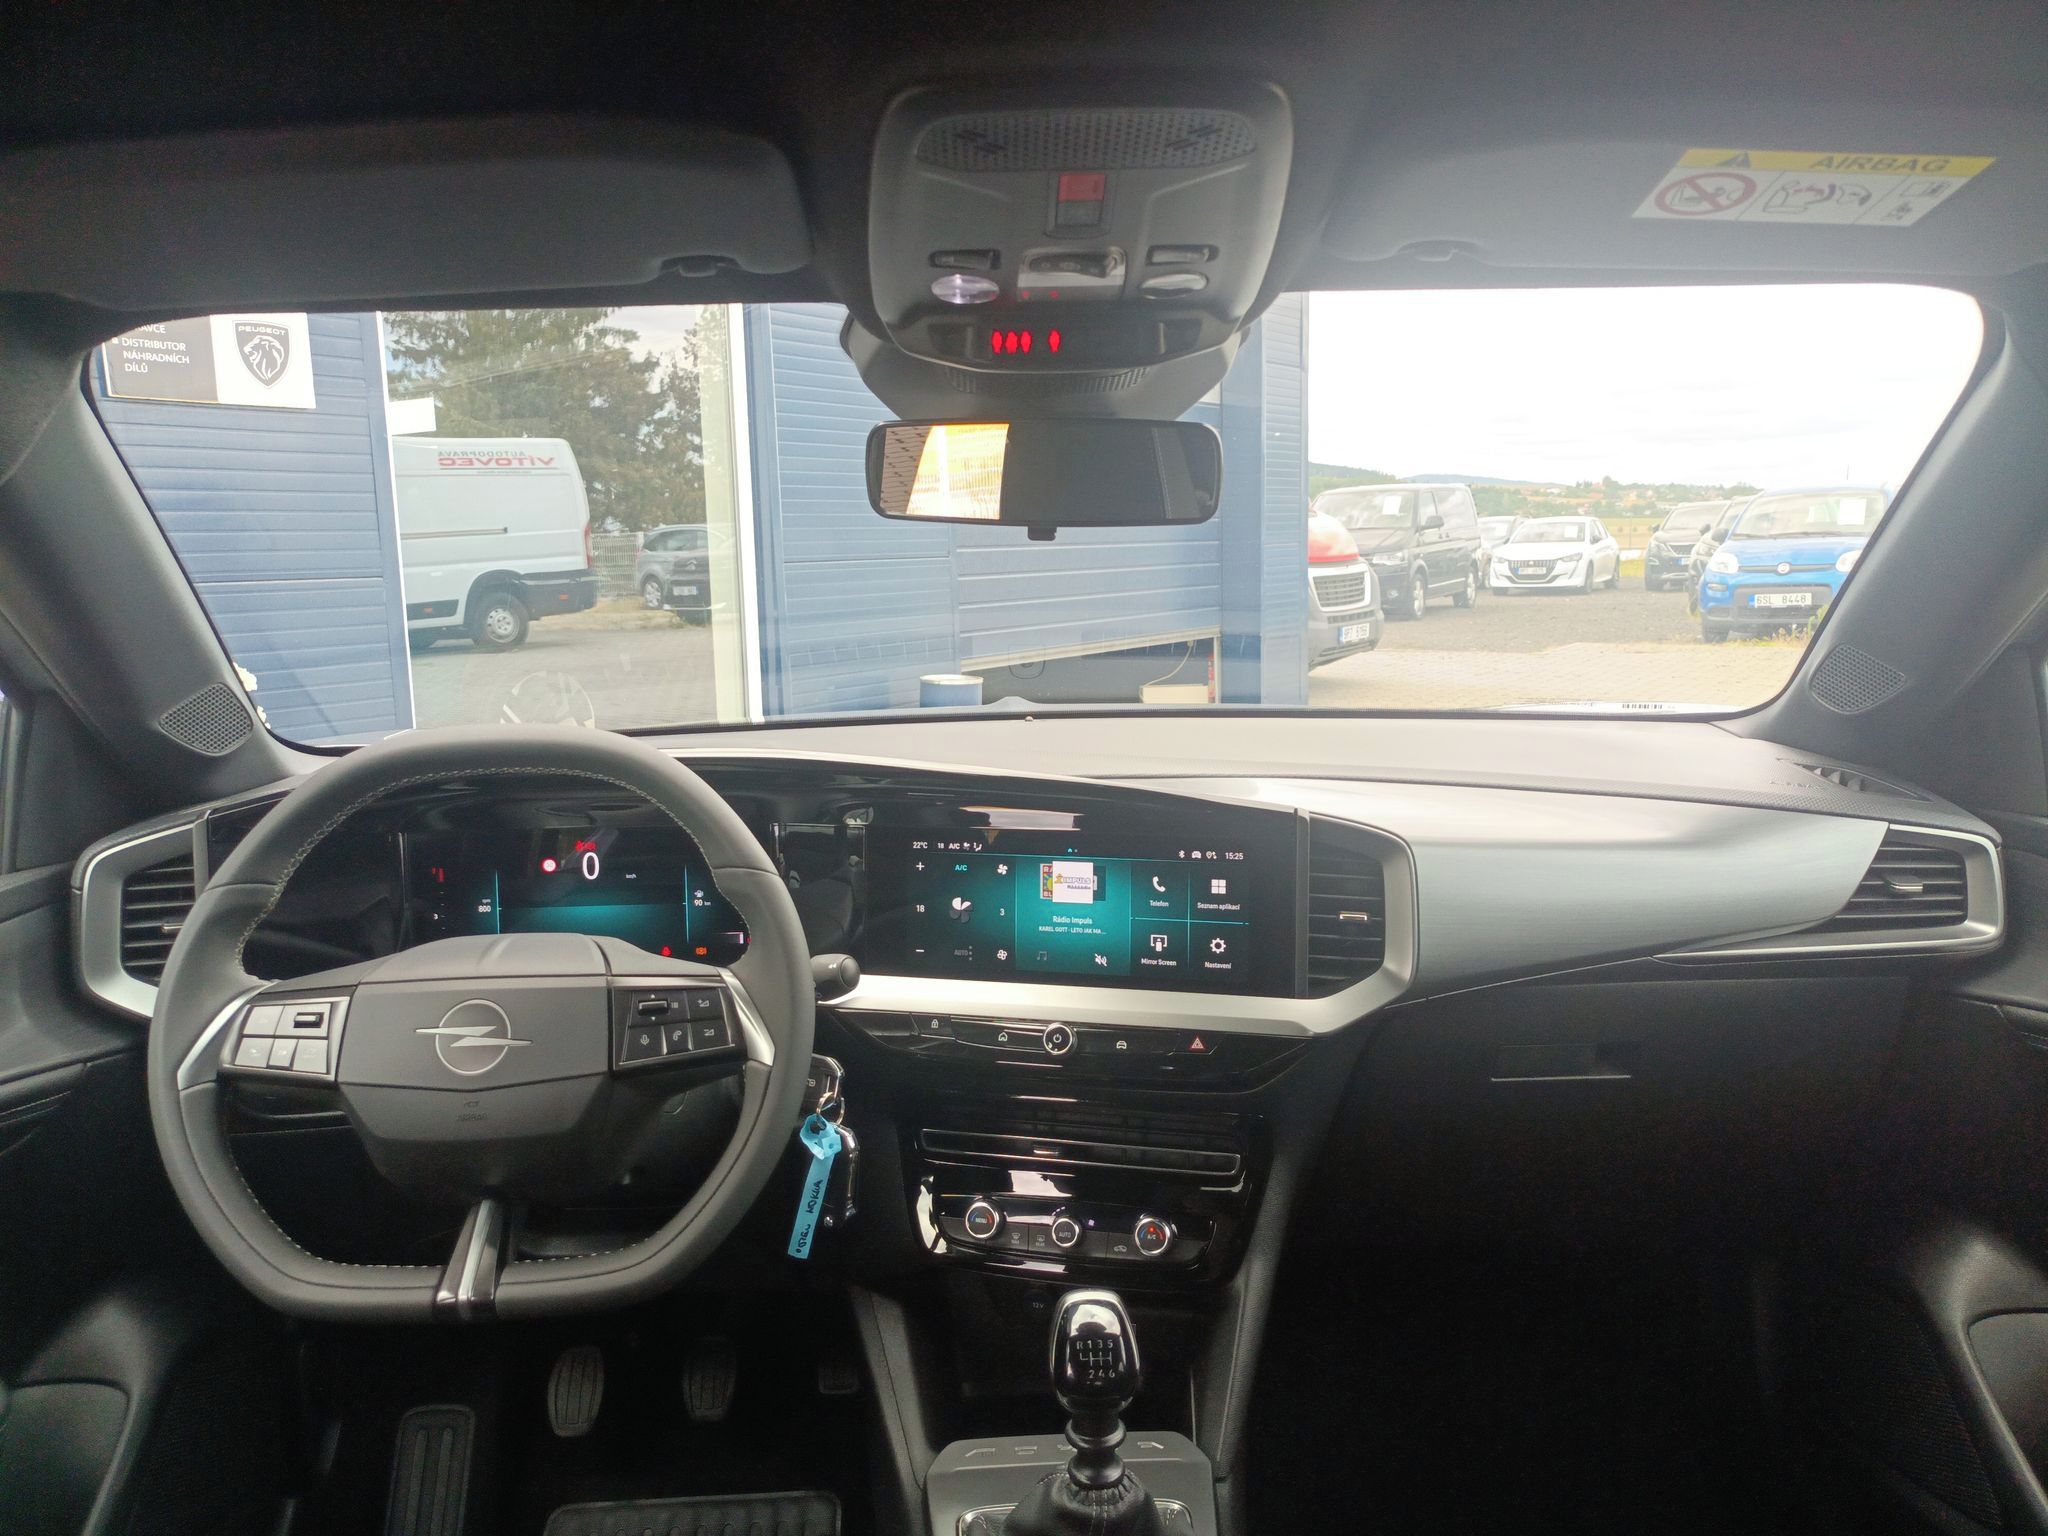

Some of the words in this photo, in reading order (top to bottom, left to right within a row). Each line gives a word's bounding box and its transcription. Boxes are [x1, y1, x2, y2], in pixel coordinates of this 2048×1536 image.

[1809, 155, 1951, 173] AIRBAG
[238, 325, 286, 336] PEUGEOT
[122, 337, 186, 351] DISTRIBUTOR
[123, 351, 190, 364] NÁHRADNÍCH
[124, 360, 148, 373] DÍLŮ
[1781, 594, 1807, 604] 8448
[912, 841, 928, 849] 22°C
[948, 842, 961, 850] A/C
[1224, 852, 1244, 860] 15:25
[582, 851, 600, 880] 0
[1063, 876, 1092, 884] IMPULS
[693, 898, 703, 907] 90
[915, 904, 925, 913] 18
[999, 908, 1005, 916] 3
[1052, 915, 1071, 924] Rádio
[1071, 916, 1093, 925] Impuls
[1140, 957, 1157, 965] Mirror
[1158, 958, 1177, 966] Screen
[1204, 961, 1232, 969] Nastavení
[1076, 1341, 1084, 1350] R
[1097, 1339, 1103, 1349] 3
[1107, 1340, 1114, 1349] 5
[1088, 1369, 1095, 1379] 2
[1098, 1369, 1105, 1378] 4
[1108, 1369, 1115, 1378] 6
